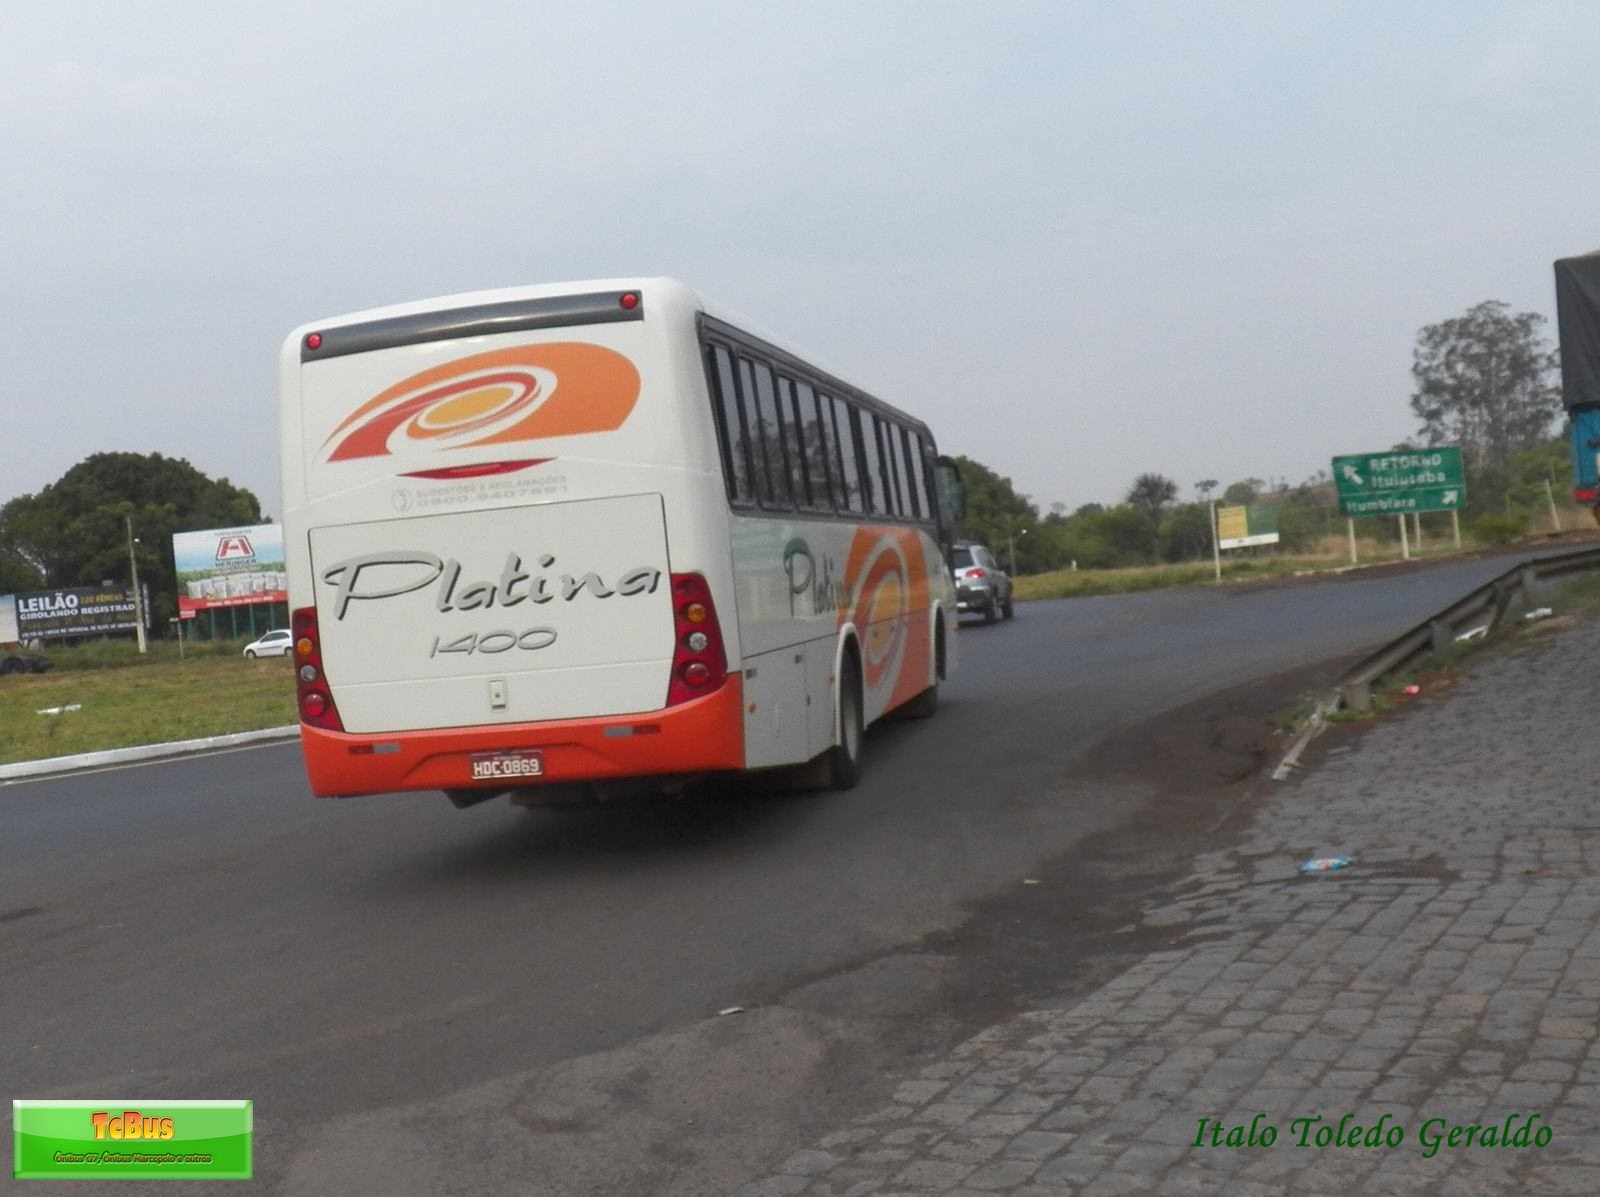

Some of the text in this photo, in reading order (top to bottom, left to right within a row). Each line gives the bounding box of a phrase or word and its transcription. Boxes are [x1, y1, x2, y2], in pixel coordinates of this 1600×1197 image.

[1369, 453, 1442, 471] RETORNO
[1372, 472, 1446, 488] Ituiutaba
[1347, 498, 1416, 512] Itumbiara
[320, 550, 663, 621] Platina
[18, 592, 79, 613] LEILÃO
[20, 603, 137, 620] GIROLANDO REGISTRAD
[429, 625, 558, 659] 1400
[473, 758, 540, 777] HDC-0869
